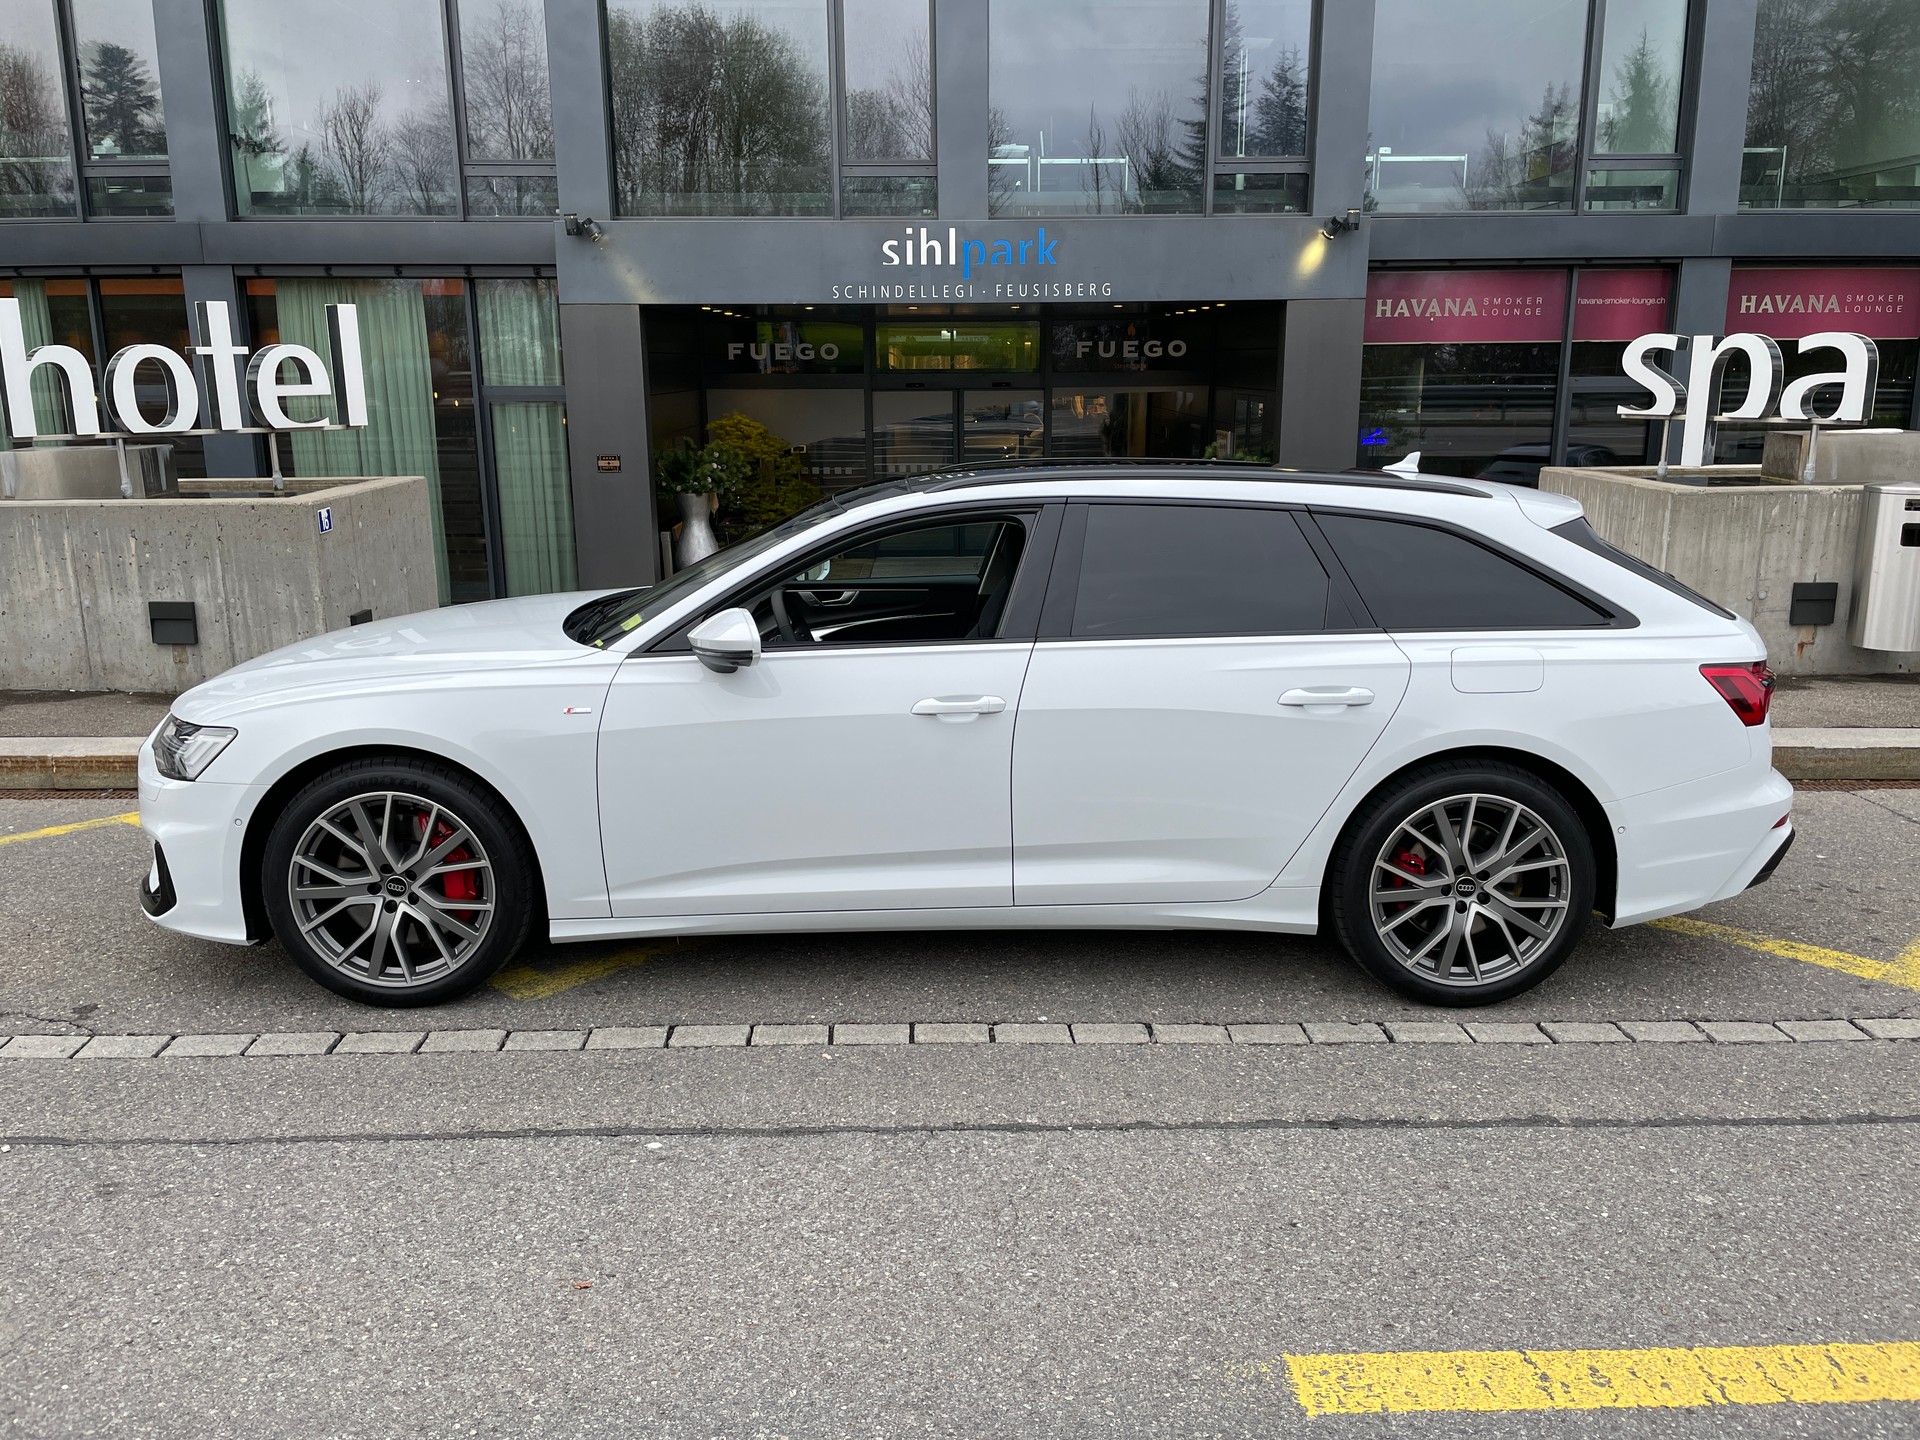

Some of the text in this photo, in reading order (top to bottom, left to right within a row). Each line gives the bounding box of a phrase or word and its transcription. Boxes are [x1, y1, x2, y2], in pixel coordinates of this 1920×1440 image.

[882, 227, 1058, 280] sihlpark
[832, 282, 1112, 299] SCHINDELLEGI FEUSISBERG
[1845, 294, 1905, 303] SMOKER
[1375, 298, 1478, 318] HAVANA
[1483, 296, 1543, 305] SMOKER
[1577, 297, 1666, 306] havana-smoker-lounge.ch
[1739, 294, 1841, 314] HAVANA
[1844, 304, 1904, 313] LOUNGE
[1482, 307, 1542, 317] LOUNGE
[727, 343, 840, 361] FUEGO
[1076, 340, 1188, 358] FUEGO
[0, 297, 368, 438] hotel
[1616, 332, 1880, 467] spa
